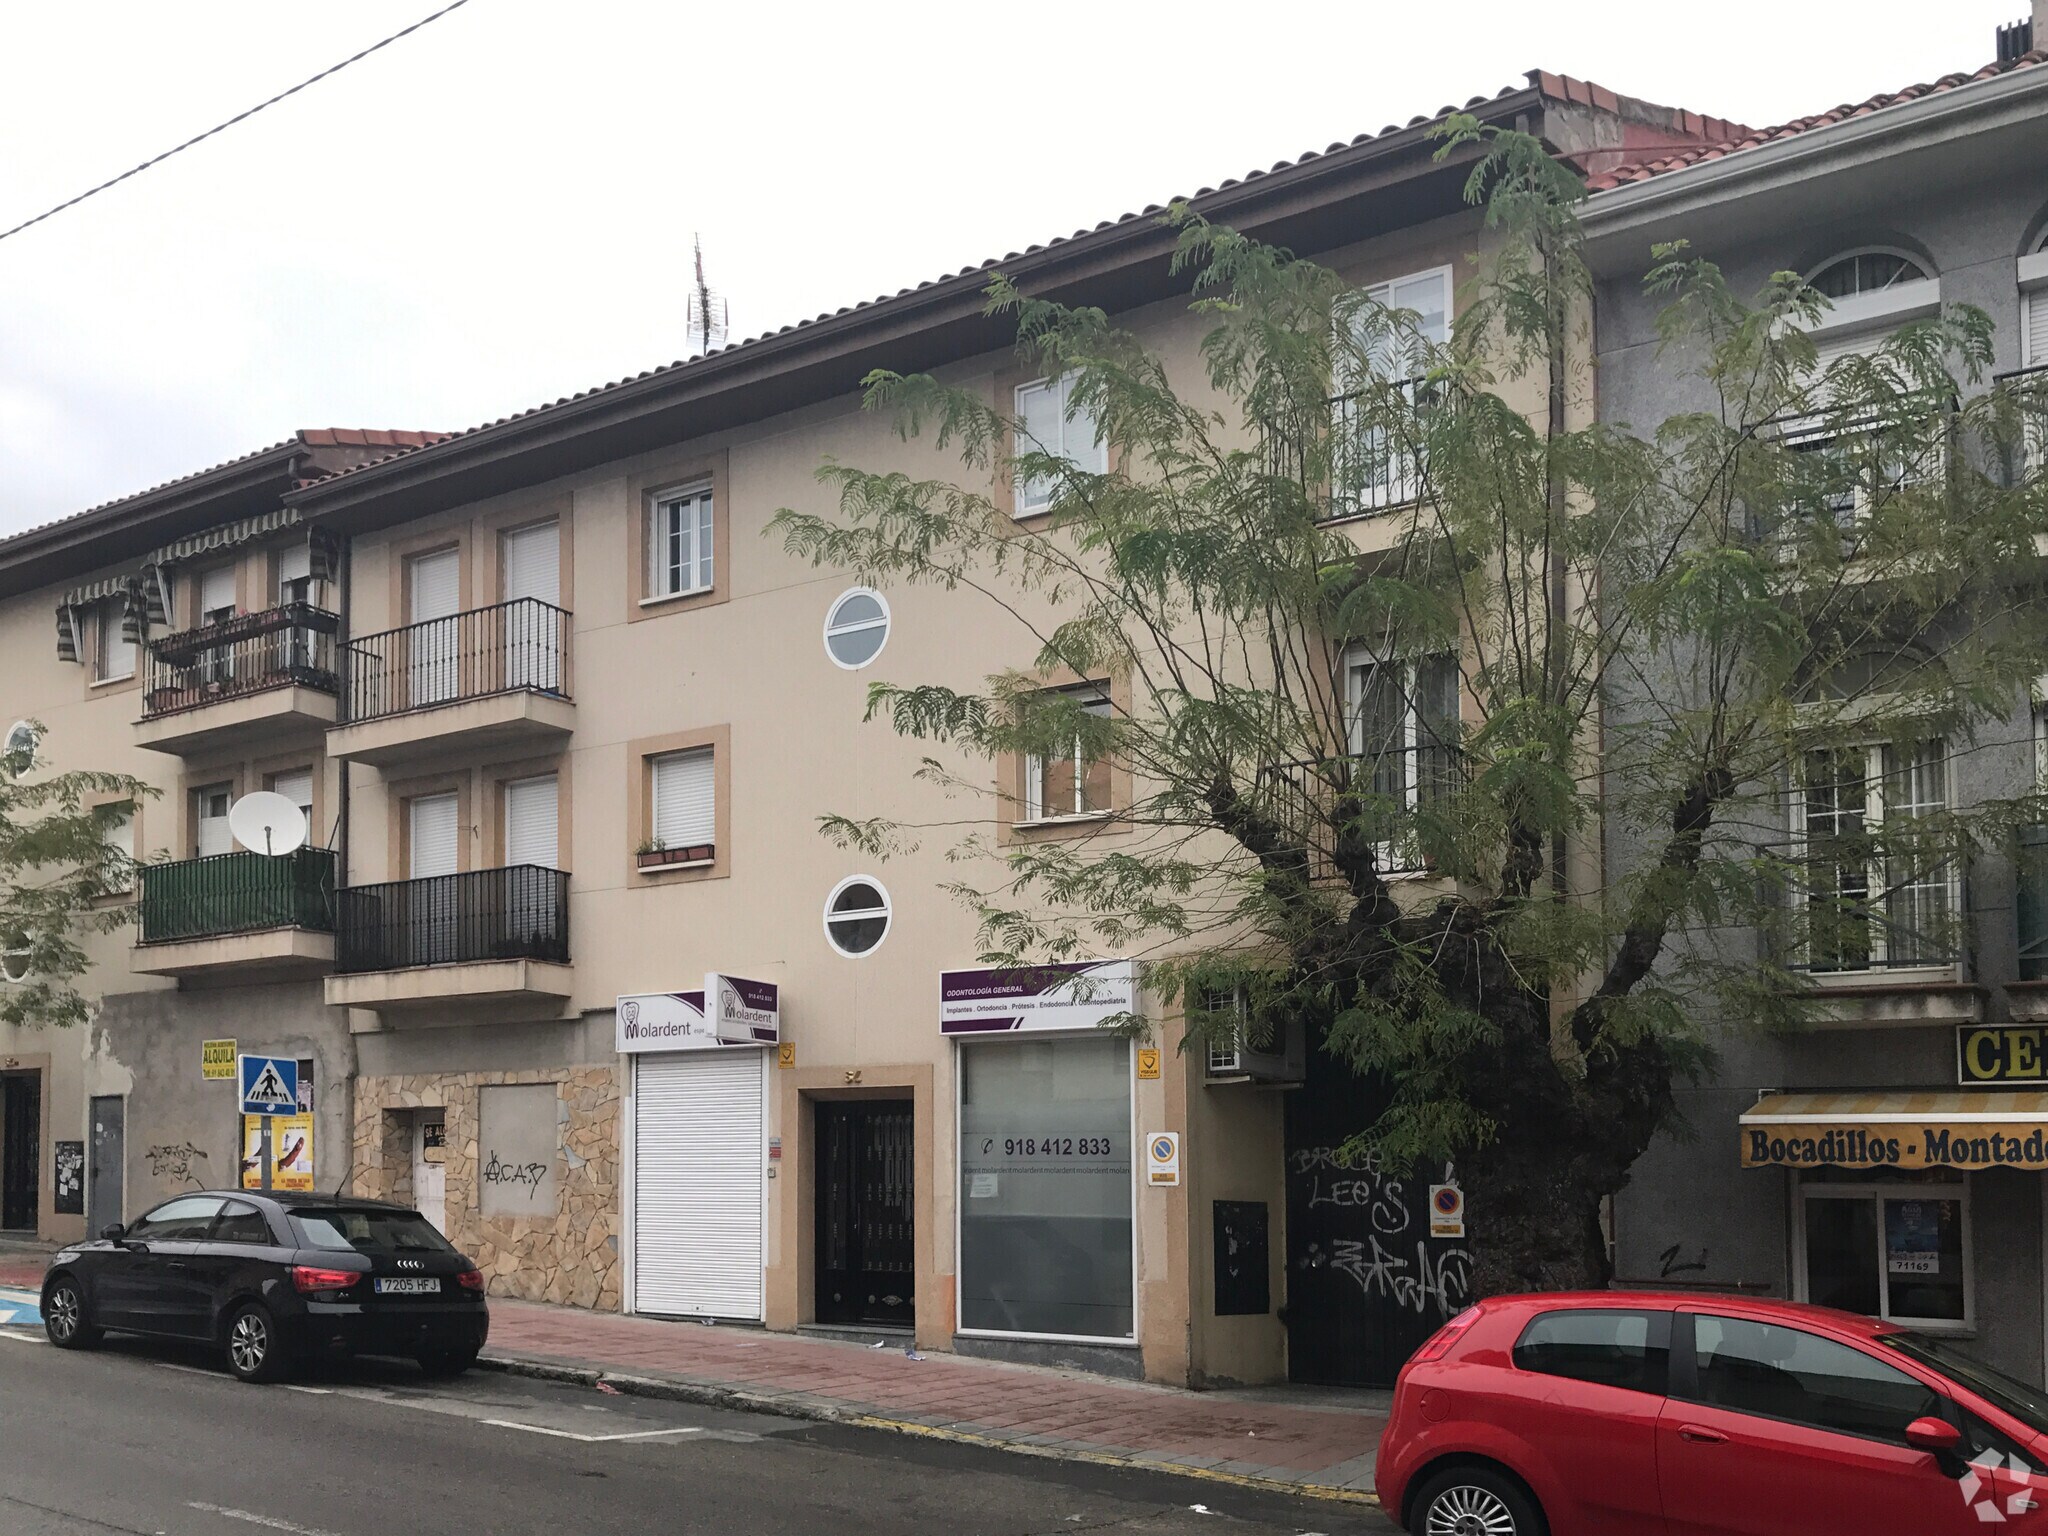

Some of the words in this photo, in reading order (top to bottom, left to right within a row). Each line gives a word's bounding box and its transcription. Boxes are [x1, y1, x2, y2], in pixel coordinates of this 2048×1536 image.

[947, 987, 992, 996] ODONTOLOGÍA
[993, 986, 1023, 994] GENERAL
[725, 1007, 772, 1024] Molardent
[976, 1004, 1007, 1012] Ortodoncia
[625, 1021, 691, 1039] Molardent
[203, 1049, 235, 1064] ALQUILA
[1966, 1030, 2048, 1079] CE
[425, 1126, 433, 1138] SE
[1005, 1138, 1035, 1155] 918
[1041, 1138, 1073, 1155] 412
[1079, 1138, 1111, 1155] 833
[1750, 1130, 1899, 1163] Bocadillos
[1924, 1129, 2048, 1163] Montad
[385, 1280, 414, 1291] 7205
[417, 1280, 437, 1291] HFJ
